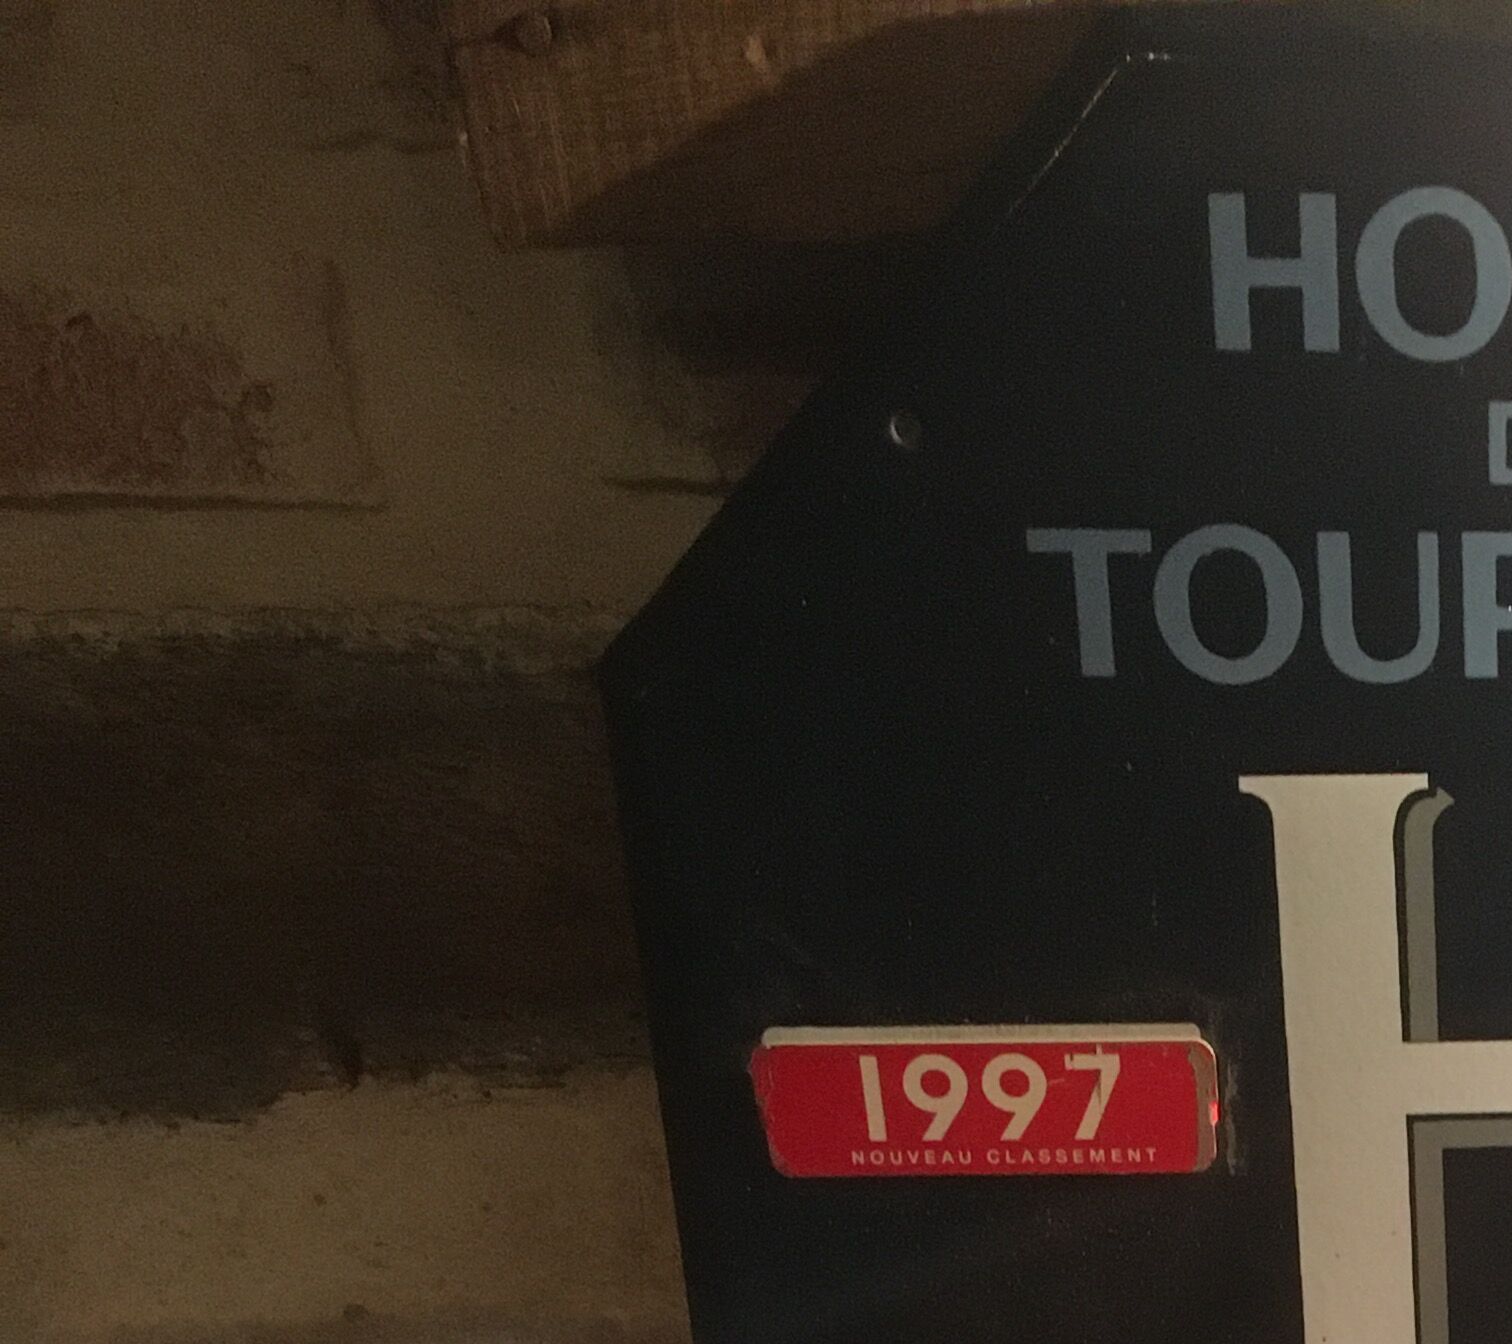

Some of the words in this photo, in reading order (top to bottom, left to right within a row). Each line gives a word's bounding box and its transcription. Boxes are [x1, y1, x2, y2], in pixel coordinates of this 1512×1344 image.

[858, 1052, 1122, 1142] 1997
[851, 1148, 973, 1166] NOUVEAU
[986, 1147, 1158, 1165] CLASSEMENT
